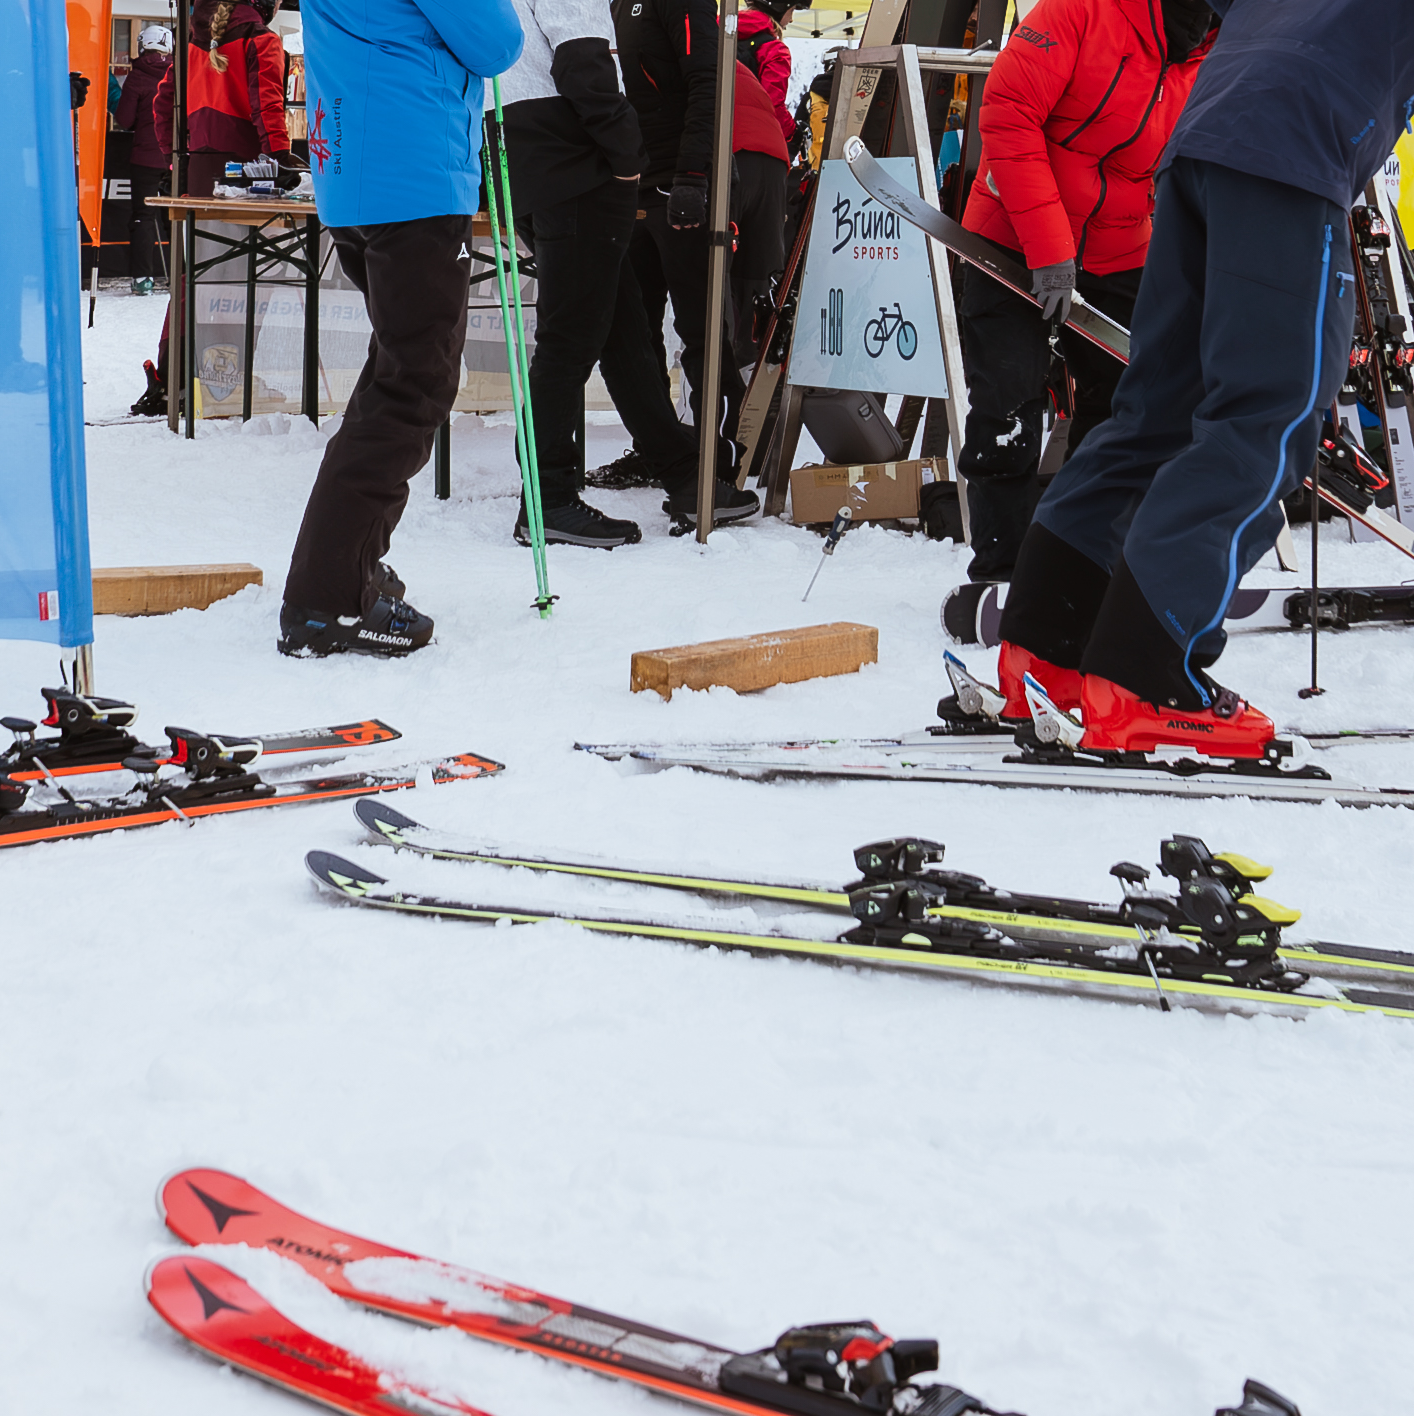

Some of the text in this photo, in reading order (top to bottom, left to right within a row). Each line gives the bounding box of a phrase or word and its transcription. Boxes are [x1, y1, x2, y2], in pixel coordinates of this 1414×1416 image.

[852, 244, 900, 262] SPORTS
[357, 629, 413, 647] SALOMON
[1165, 717, 1215, 734] ATOMIC
